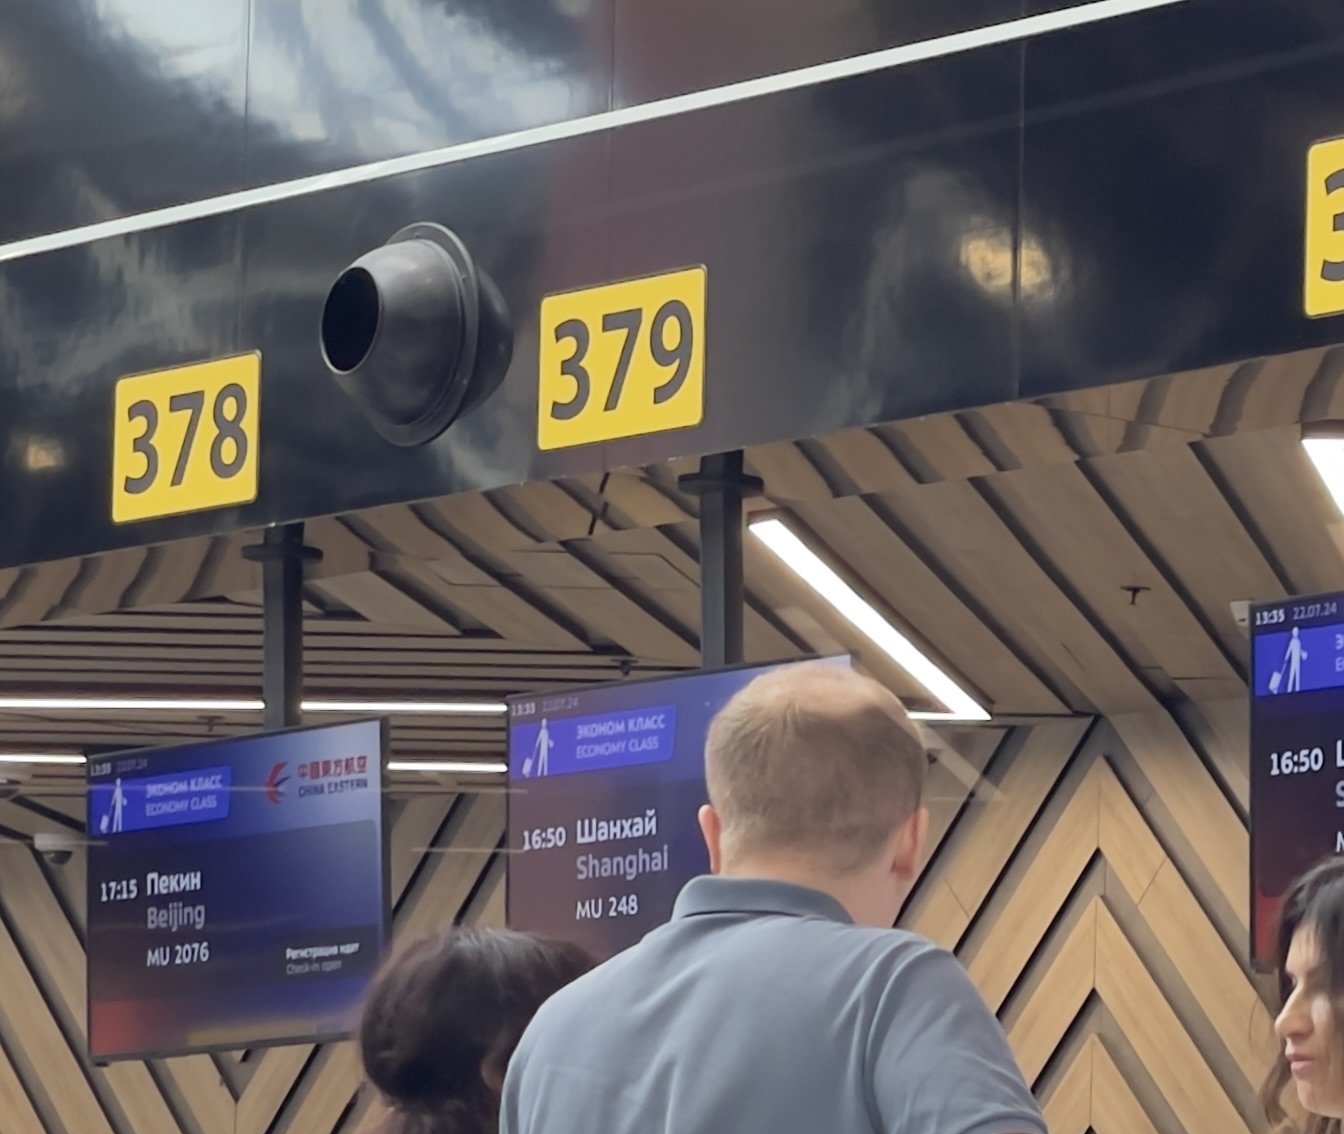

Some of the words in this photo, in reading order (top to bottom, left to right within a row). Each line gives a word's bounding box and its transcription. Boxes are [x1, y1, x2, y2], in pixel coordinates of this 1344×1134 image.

[550, 299, 694, 421] 379
[123, 382, 249, 496] 378
[1255, 608, 1285, 626] 13:35
[1292, 602, 1337, 620] 22.07.24
[1270, 747, 1323, 776] 16:50
[523, 827, 566, 850] 16:50
[576, 809, 657, 844] Шанхай
[576, 845, 668, 881] Shanghai
[100, 879, 138, 902] 17:15
[146, 870, 201, 895] Пекин
[147, 902, 205, 932] Beijing
[576, 899, 602, 920] MU
[608, 894, 638, 917] 248
[146, 948, 170, 967] MU
[175, 942, 209, 964] 2076
